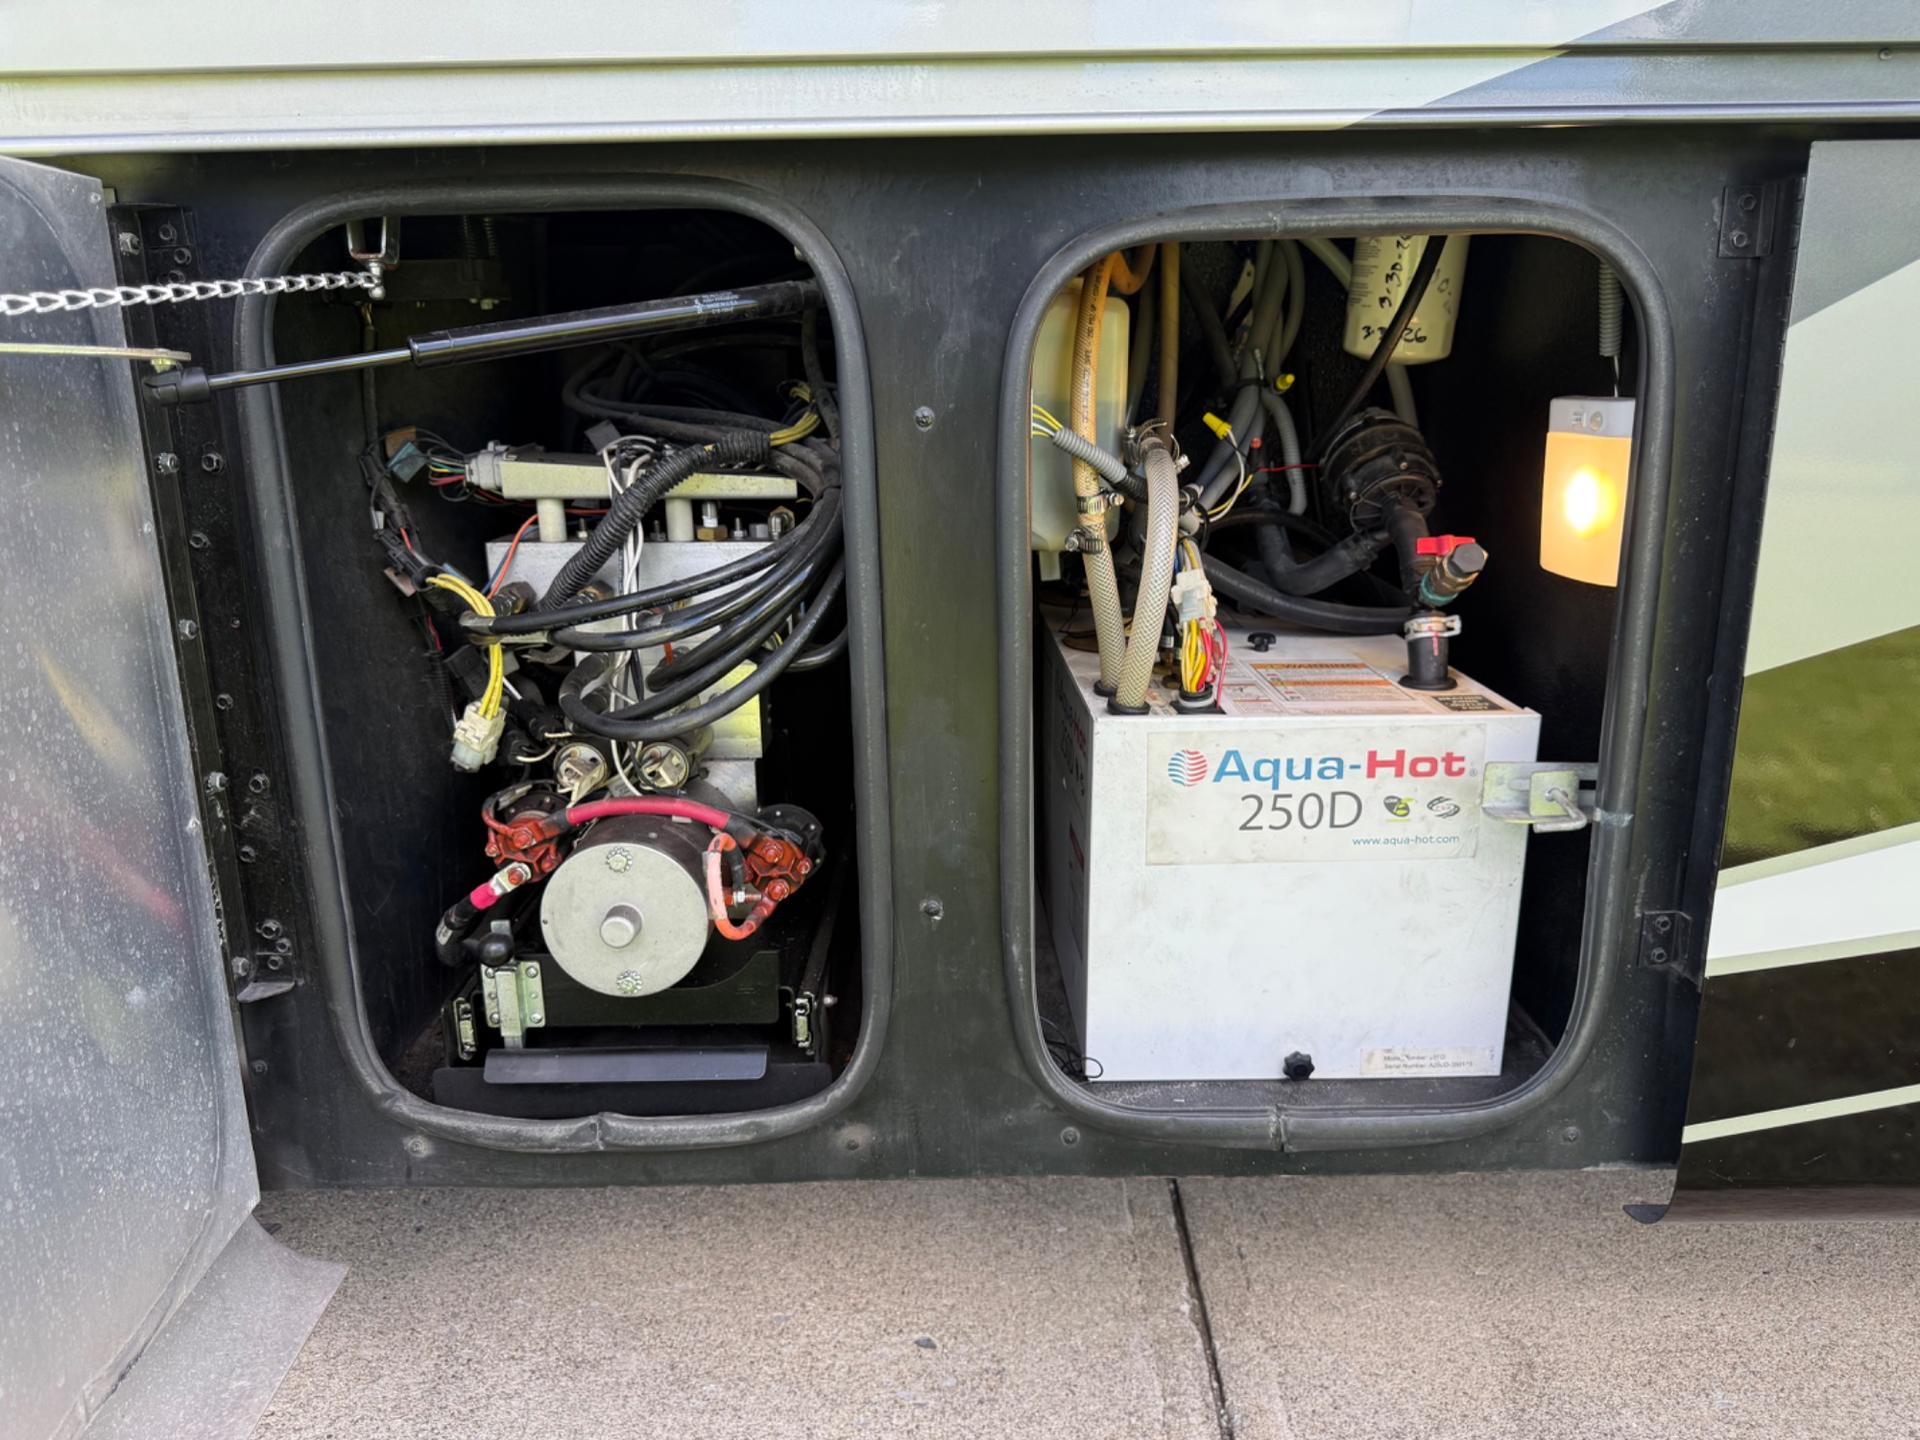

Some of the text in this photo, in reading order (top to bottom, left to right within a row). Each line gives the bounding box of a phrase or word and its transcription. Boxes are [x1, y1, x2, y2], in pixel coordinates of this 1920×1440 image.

[1212, 749, 1466, 791] Aqua-Hot
[1238, 791, 1363, 831] 250D
[1352, 834, 1460, 847] www.aqua-hot.com
